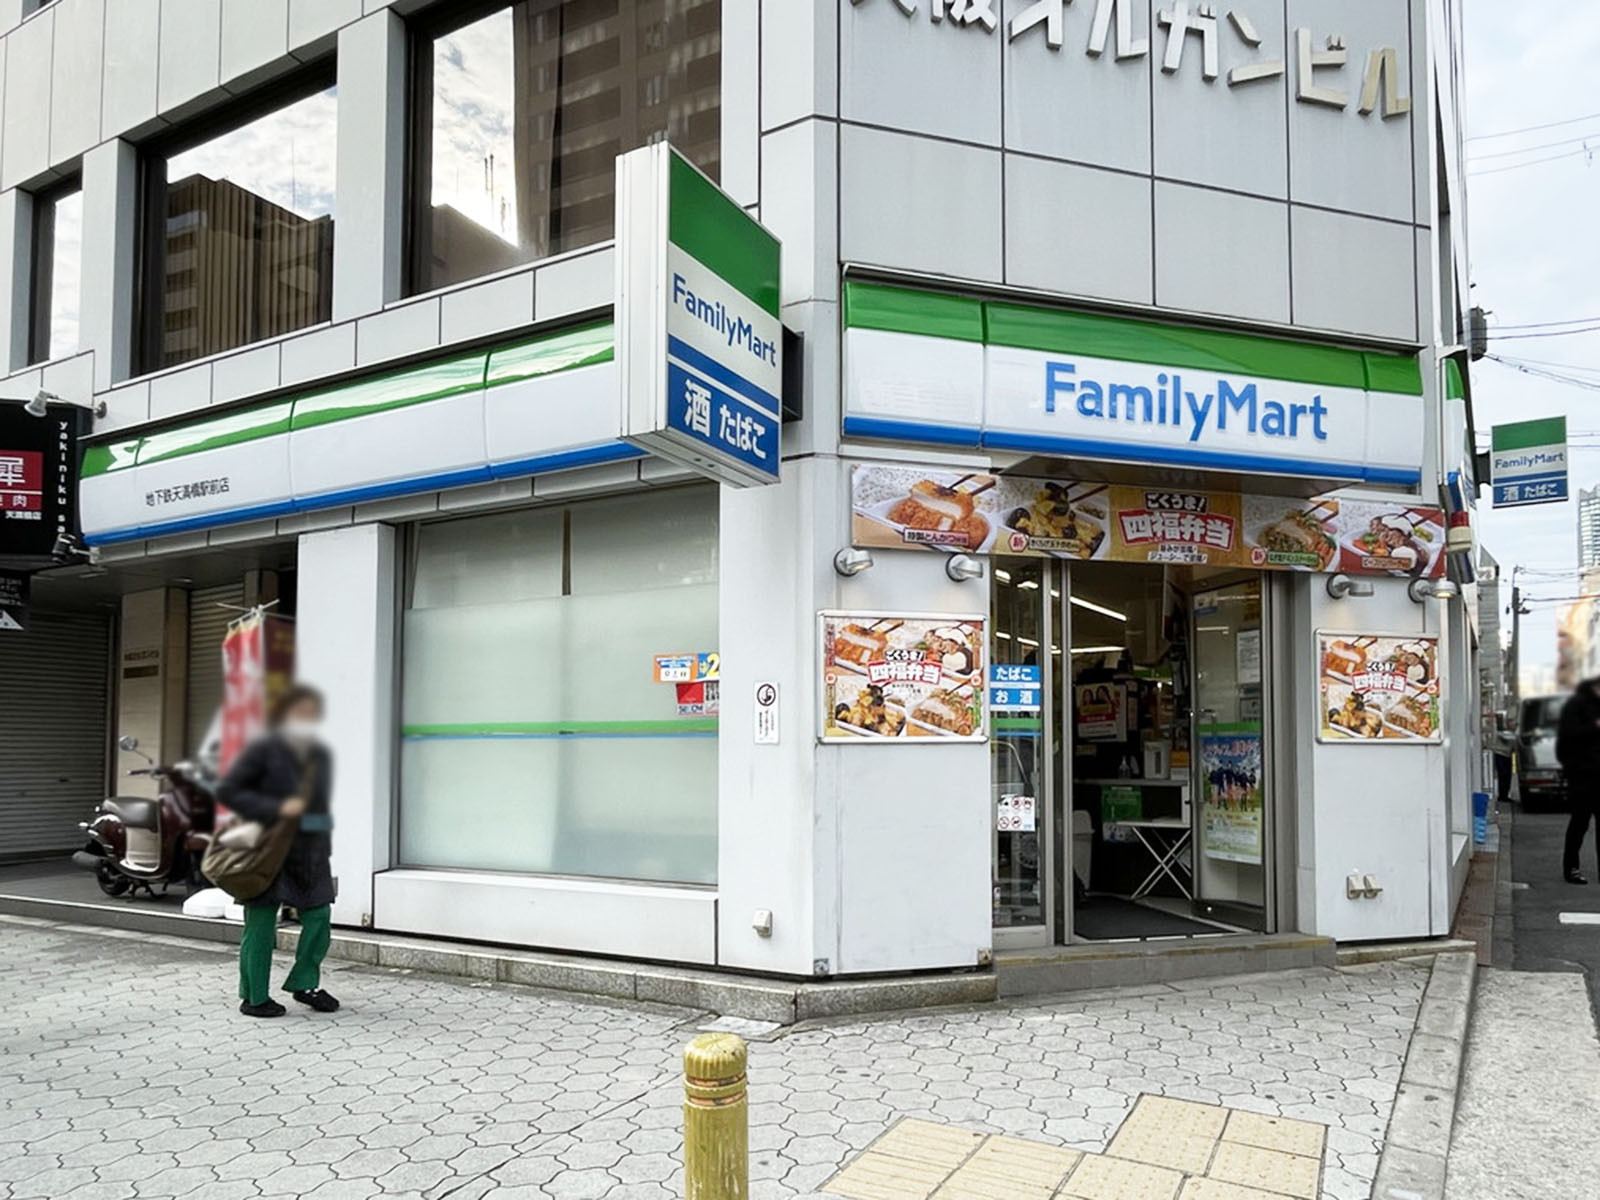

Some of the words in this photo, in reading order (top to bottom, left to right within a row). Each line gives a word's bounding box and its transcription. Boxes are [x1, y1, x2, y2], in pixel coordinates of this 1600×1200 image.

[673, 272, 776, 367] FamilyMart
[1044, 360, 1328, 441] FamilyMart
[684, 378, 711, 438] 酒
[719, 403, 768, 460] たばこ
[57, 421, 68, 505] yakiniku
[1495, 452, 1564, 469] FamilyMart
[1503, 486, 1519, 501] 酒
[1524, 483, 1559, 498] たばこ
[1120, 512, 1232, 548] 四福弁当
[869, 661, 940, 684] 四福弁当
[996, 666, 1033, 681] たばこ
